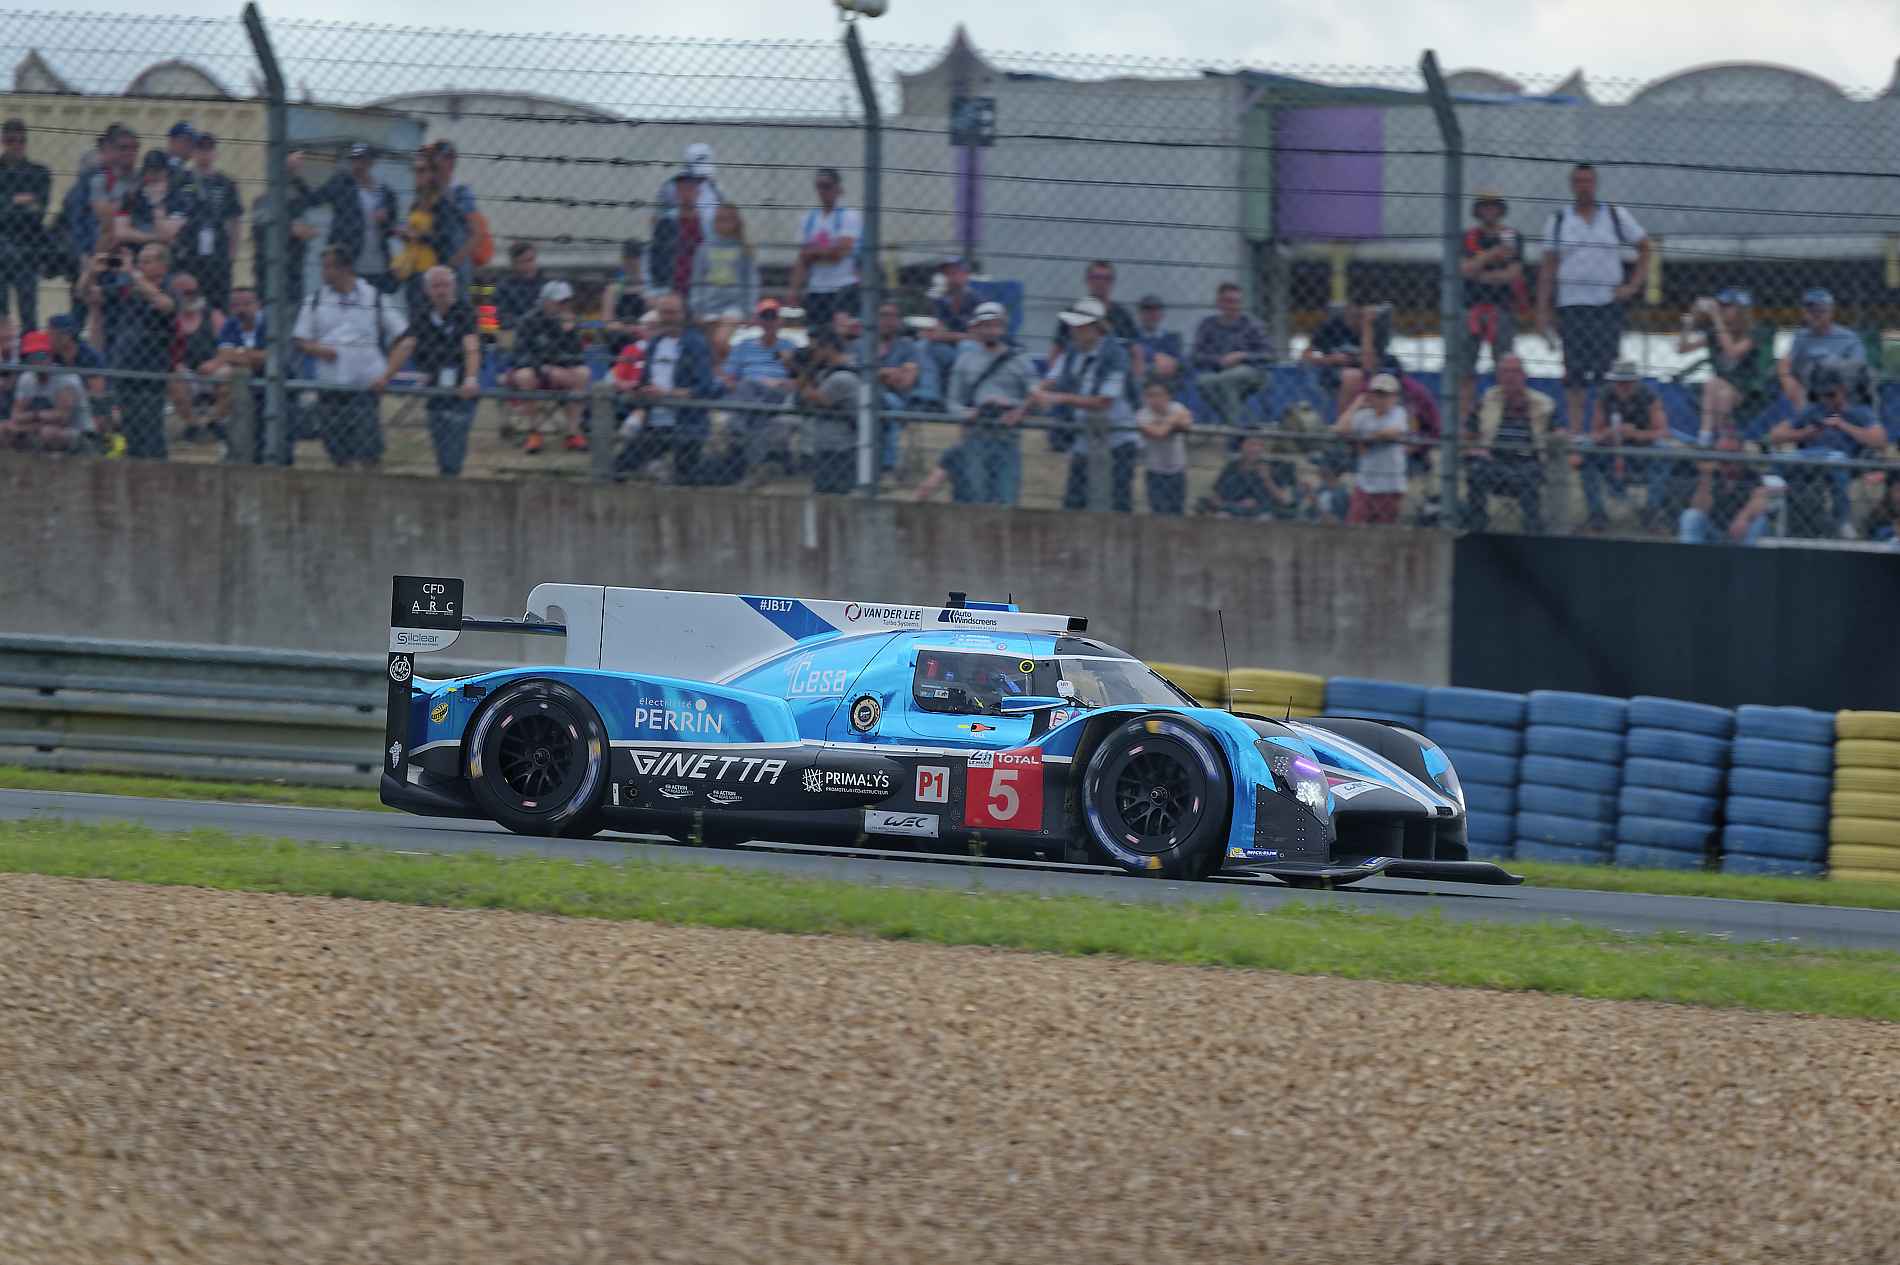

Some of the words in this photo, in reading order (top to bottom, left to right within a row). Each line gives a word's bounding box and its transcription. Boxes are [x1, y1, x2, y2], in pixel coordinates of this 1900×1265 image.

[422, 583, 445, 594] CFD
[760, 599, 793, 612] #JB17
[864, 607, 882, 619] VAN
[883, 609, 902, 619] DER
[904, 610, 921, 620] LEE
[954, 610, 972, 618] Auto
[954, 617, 997, 626] Windscreens
[396, 631, 439, 645] Silclear
[635, 705, 722, 734] PERRIN
[996, 752, 1040, 765] TOTAL
[630, 749, 788, 785] GINETTA
[825, 770, 889, 788] PRIMALYS
[919, 771, 943, 800] P1
[987, 769, 1020, 821] 5
[883, 816, 929, 828] WEC
